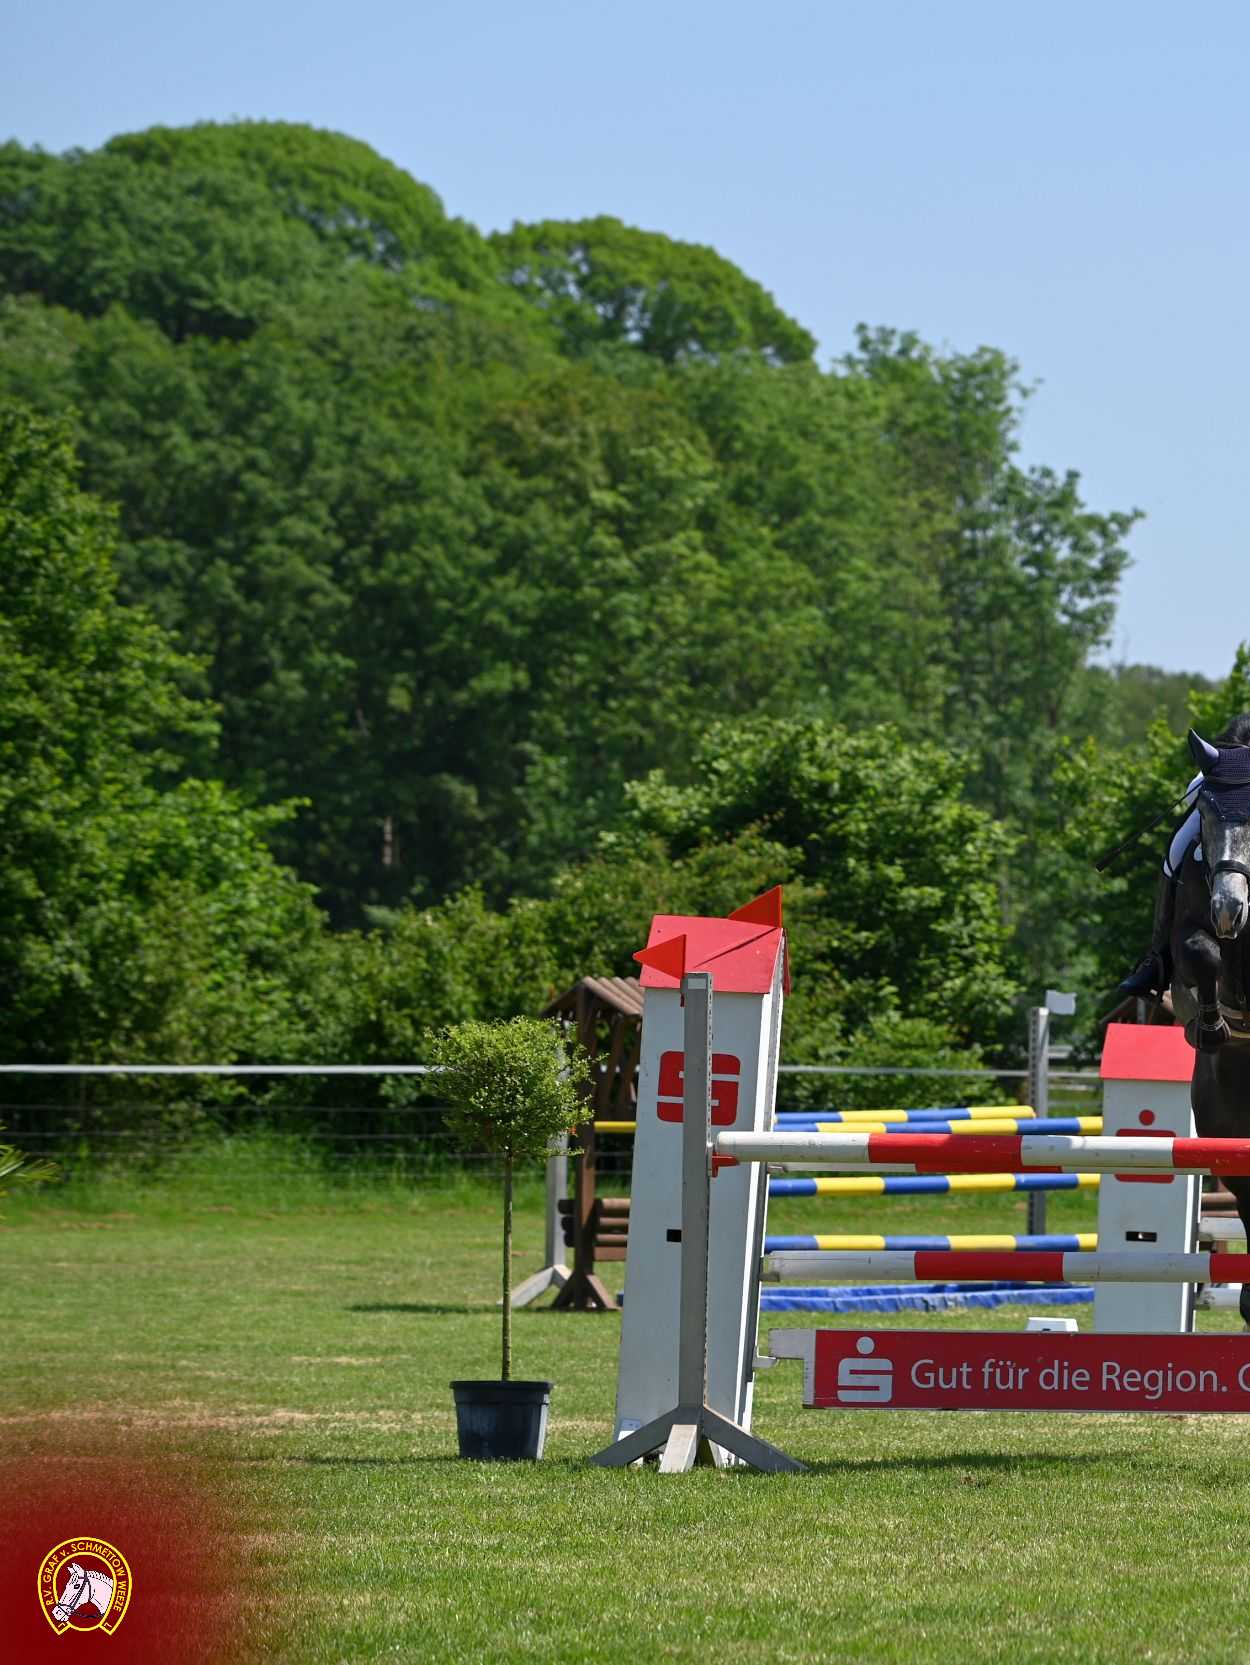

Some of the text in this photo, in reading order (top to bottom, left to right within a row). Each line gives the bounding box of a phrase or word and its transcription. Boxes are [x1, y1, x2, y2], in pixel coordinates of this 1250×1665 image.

[837, 1357, 893, 1403] S
[910, 1359, 972, 1390] Gut
[981, 1359, 1030, 1390] für
[1038, 1359, 1091, 1391] die
[1102, 1361, 1229, 1400] Region.
